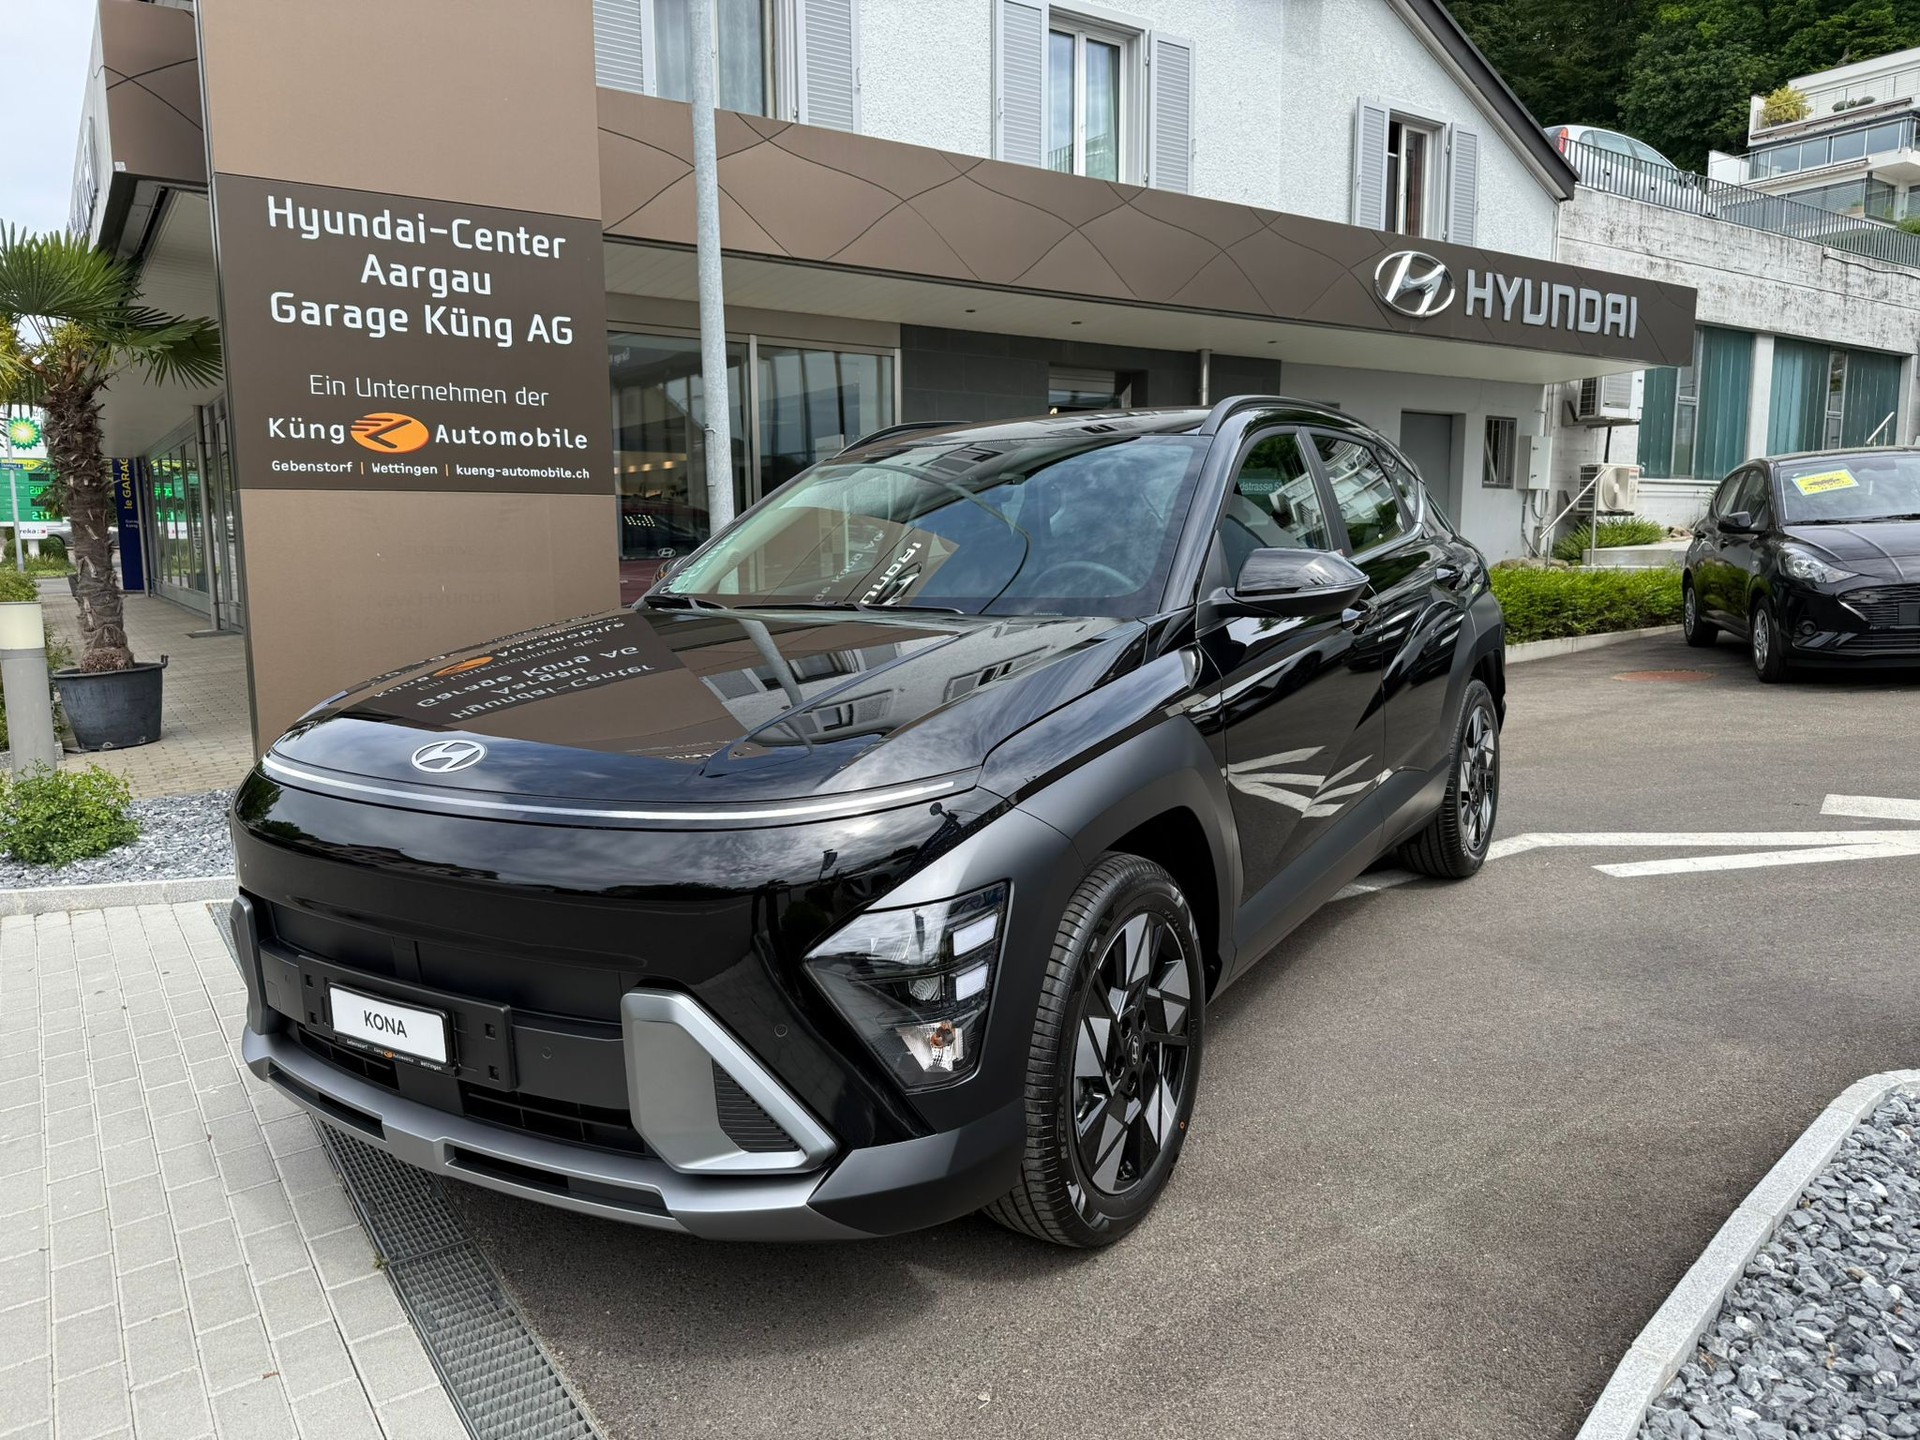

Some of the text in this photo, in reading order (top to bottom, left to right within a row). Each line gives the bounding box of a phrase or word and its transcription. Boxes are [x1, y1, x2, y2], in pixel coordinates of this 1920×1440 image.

[267, 194, 567, 260] Hyundai-Center
[360, 253, 492, 299] Aargau
[270, 291, 574, 348] Garage Küng AG
[1465, 268, 1639, 339] HYUNDAI
[309, 374, 550, 407] Ein Unternehmen der
[267, 417, 589, 450] Küng Automobile
[120, 457, 132, 498] GARAG
[271, 460, 590, 479] Gebenstorf Wettingen kueng-automobile.ch
[363, 1009, 408, 1039] KONA
